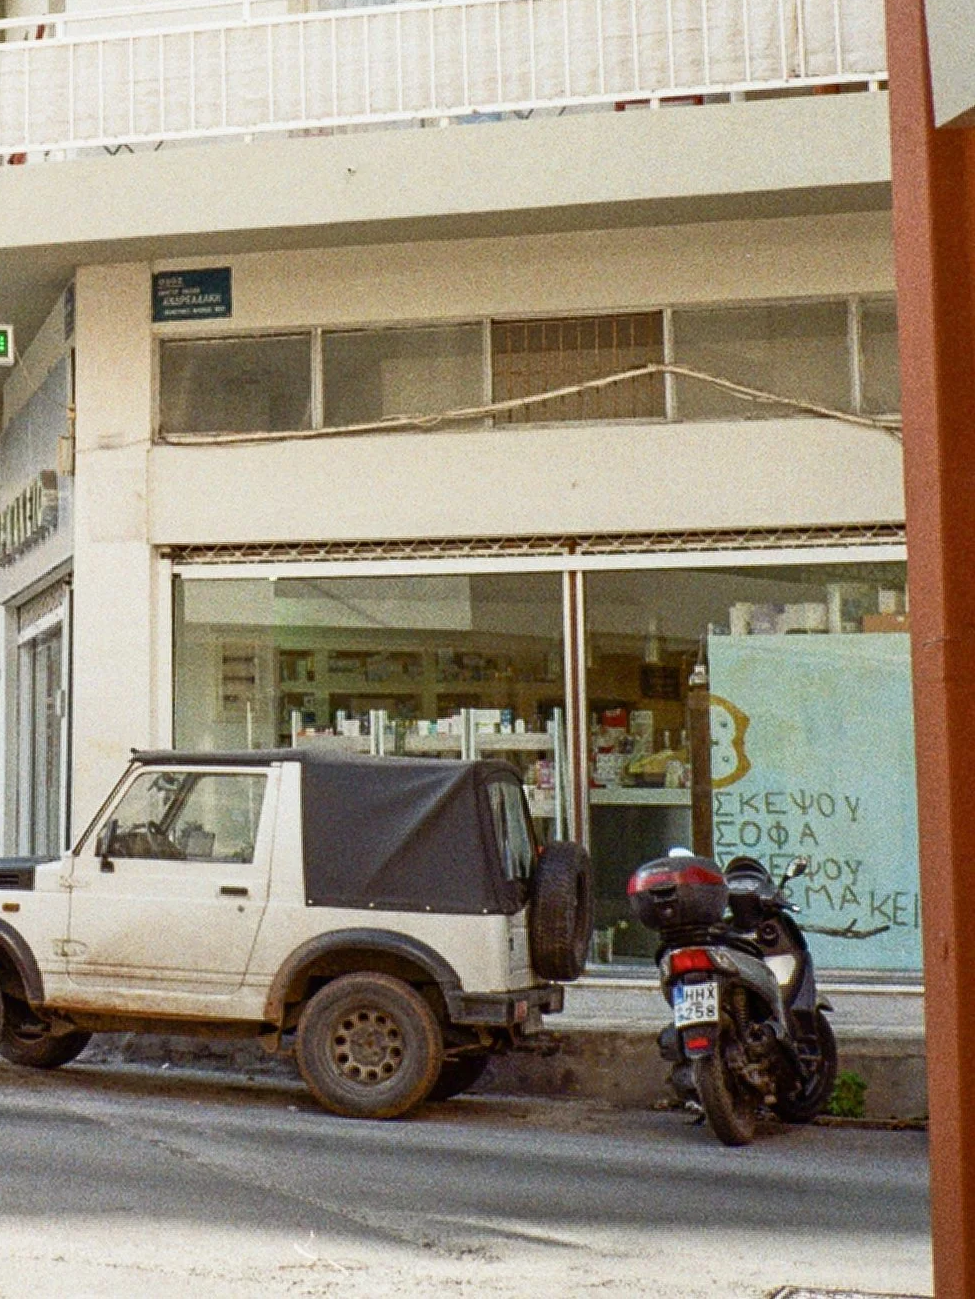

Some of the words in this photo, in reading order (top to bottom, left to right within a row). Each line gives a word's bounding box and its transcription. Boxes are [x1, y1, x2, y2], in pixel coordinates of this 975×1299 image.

[714, 789, 860, 822] ΣΚΕΨΟΥ
[715, 820, 819, 850] ΣΟΦΑ
[716, 851, 862, 886] ΣΕΨΟΥ
